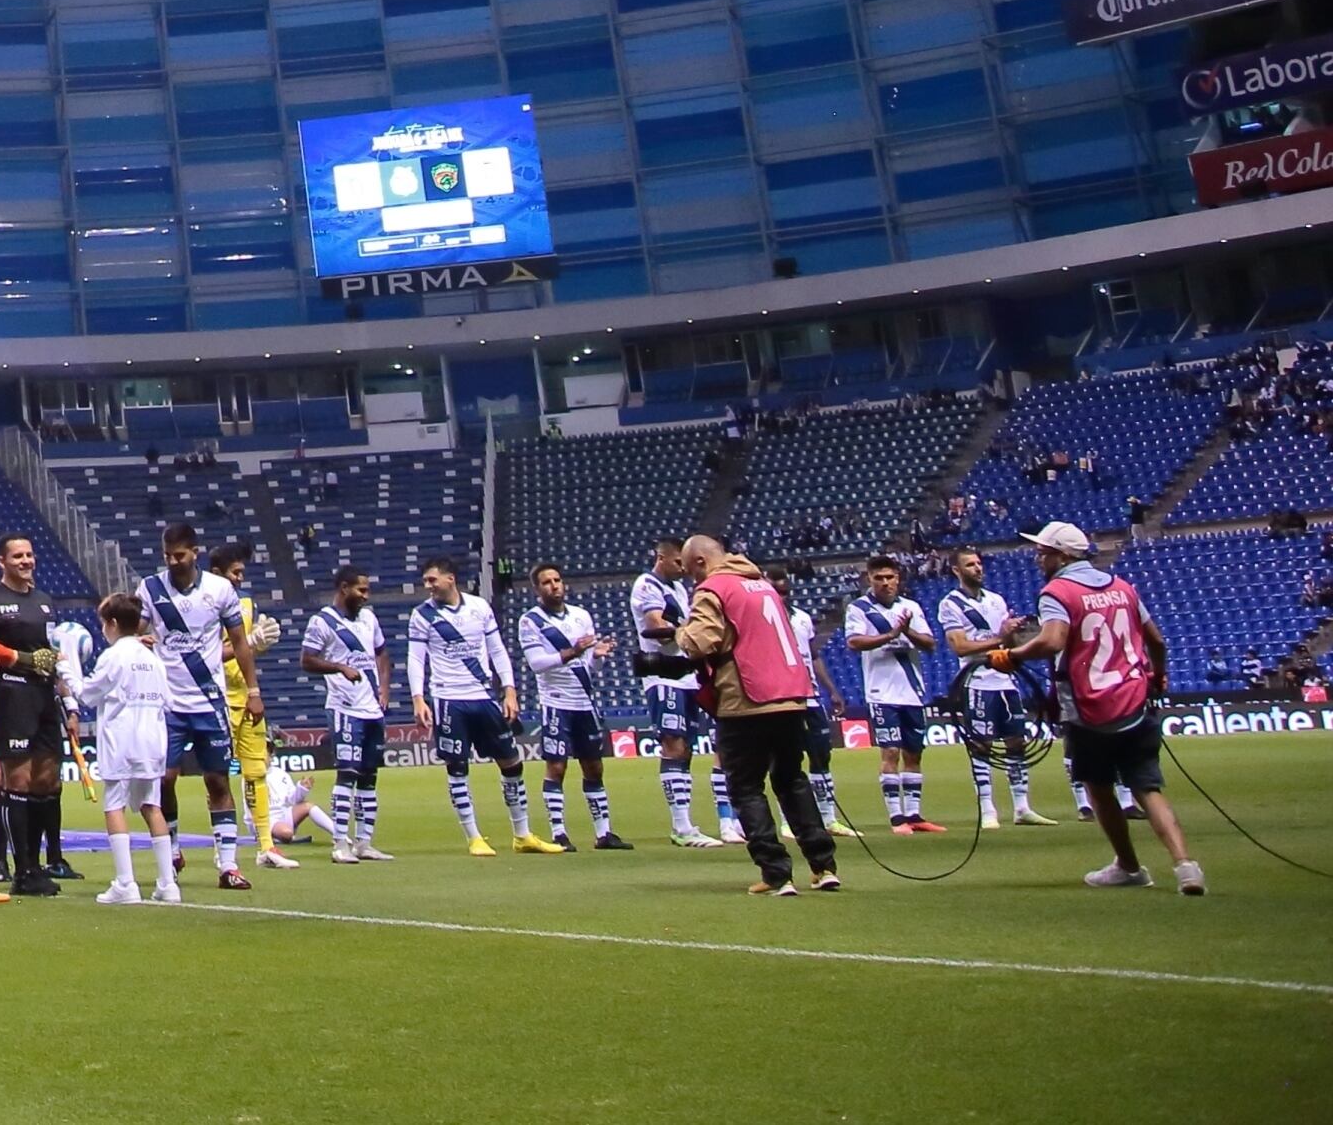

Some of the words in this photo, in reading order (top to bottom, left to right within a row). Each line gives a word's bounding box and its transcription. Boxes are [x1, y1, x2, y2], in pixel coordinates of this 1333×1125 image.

[341, 266, 487, 299] PIRMA
[1081, 590, 1129, 611] PRENSA
[0, 604, 20, 613] FMF
[762, 594, 798, 666] 1
[1081, 608, 1141, 691] 21
[890, 726, 901, 741] 21
[987, 721, 994, 735] 2
[9, 739, 29, 749] FMF
[454, 739, 462, 754] 3
[558, 743, 566, 756] 6
